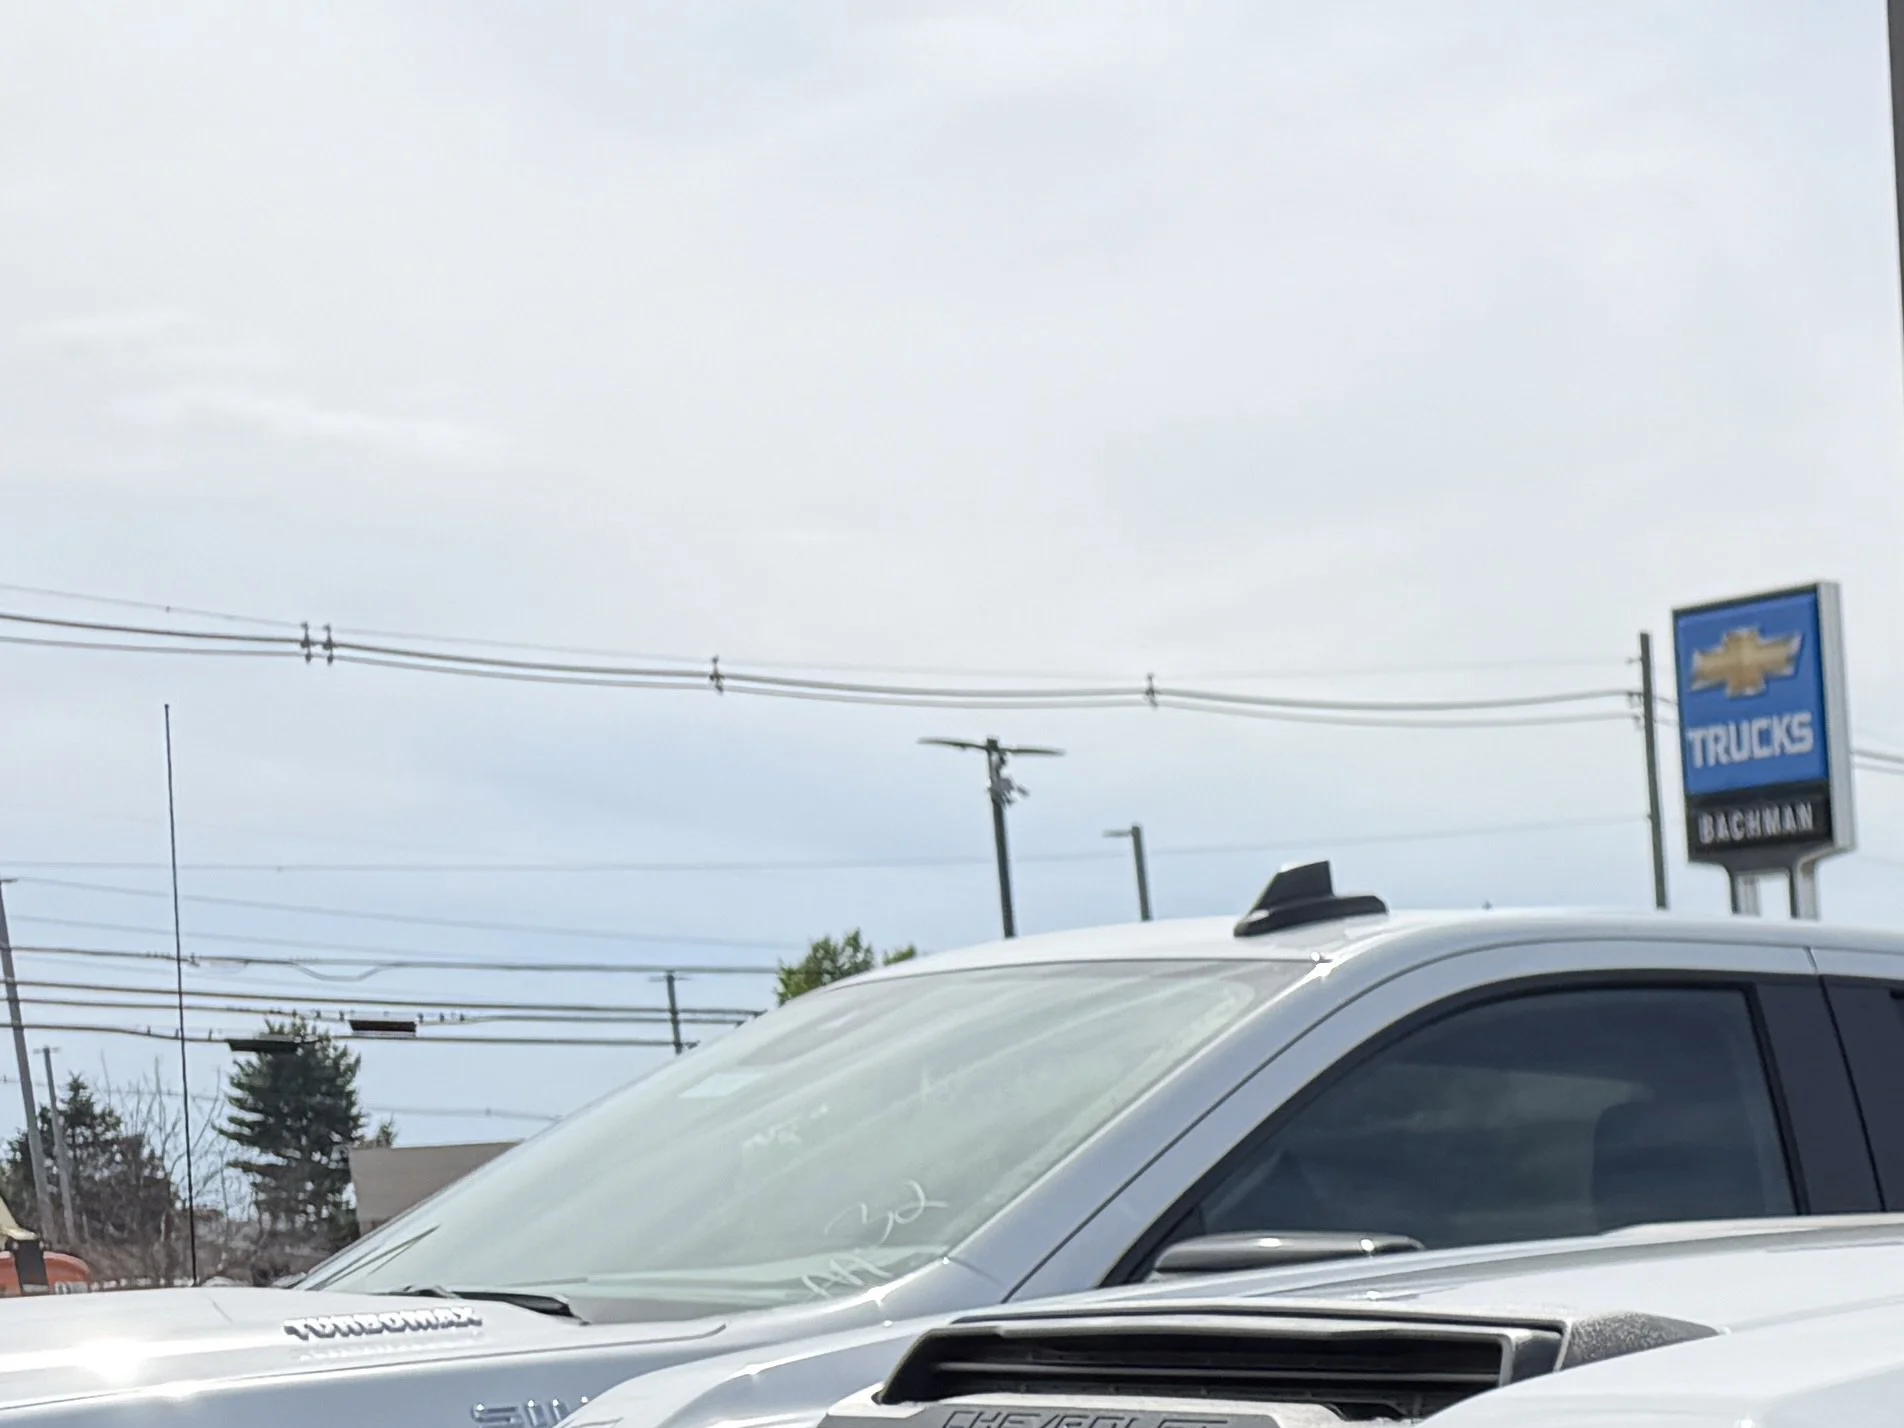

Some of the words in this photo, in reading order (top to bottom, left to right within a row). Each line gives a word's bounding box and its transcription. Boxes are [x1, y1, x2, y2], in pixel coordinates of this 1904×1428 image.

[1688, 712, 1814, 768] TRUCKS
[1701, 802, 1814, 844] BACHMAN
[283, 1307, 482, 1340] TURBOMAX
